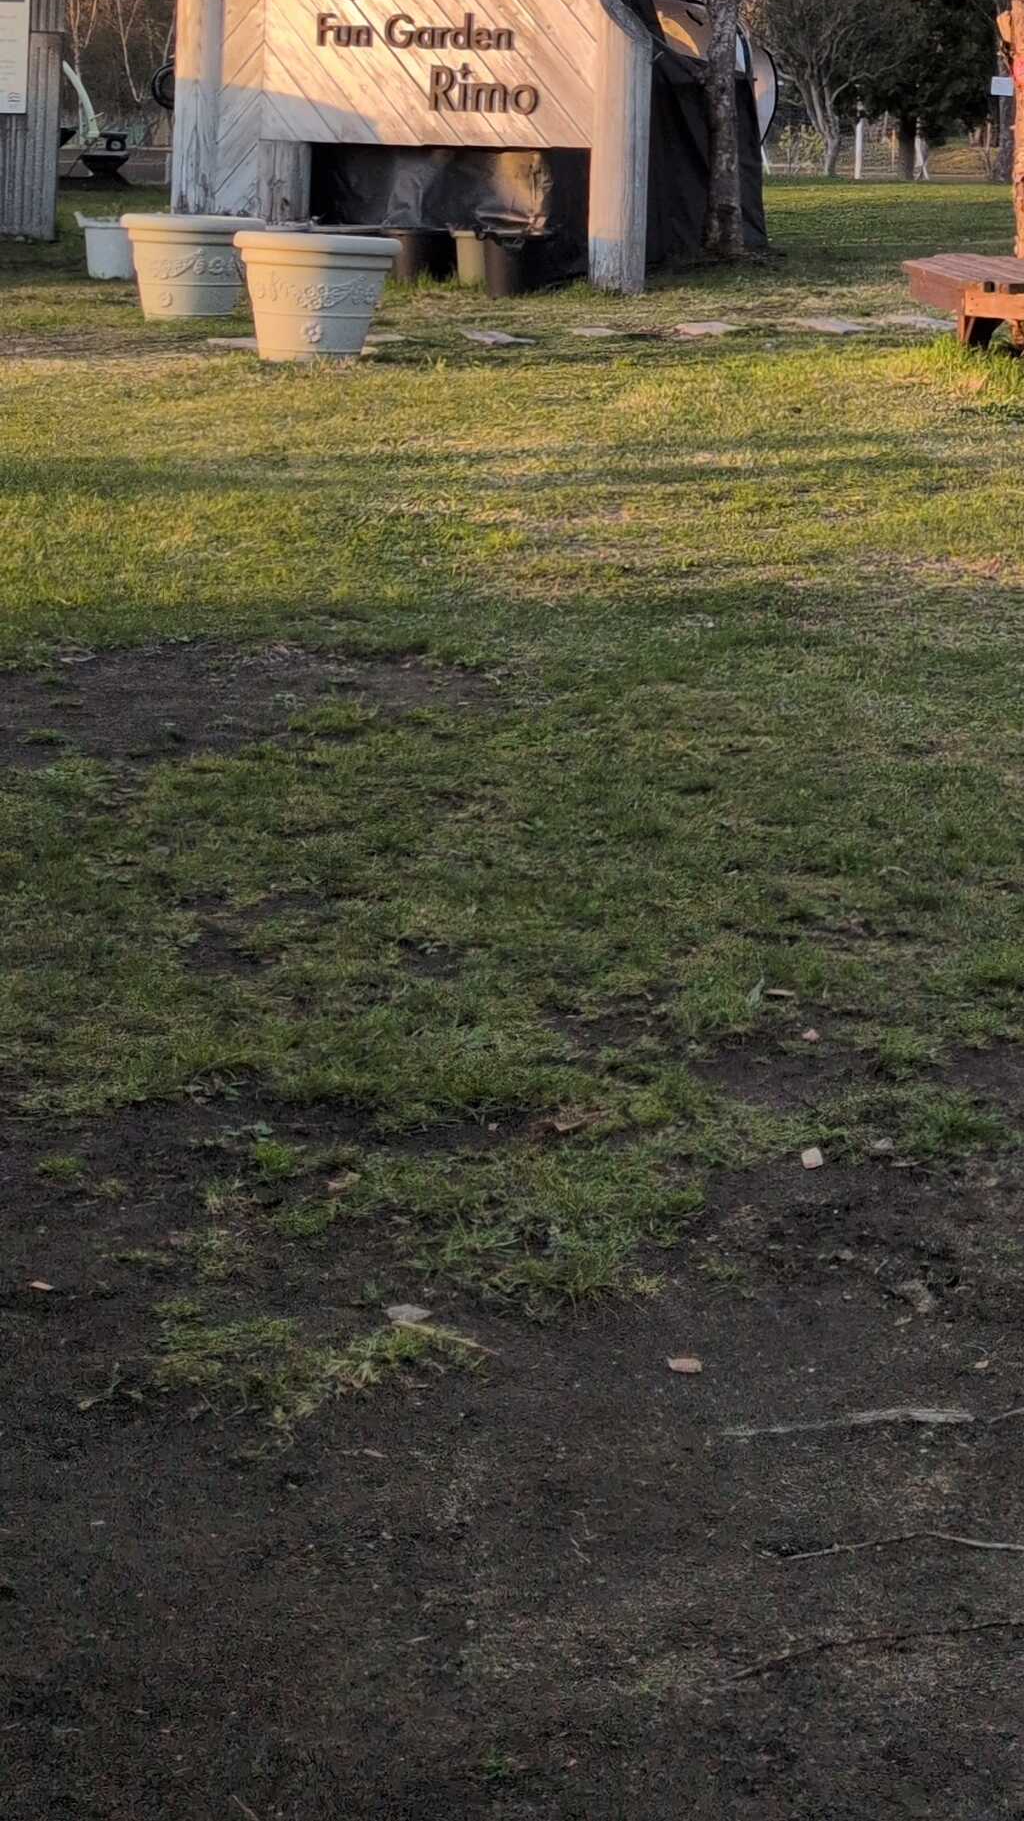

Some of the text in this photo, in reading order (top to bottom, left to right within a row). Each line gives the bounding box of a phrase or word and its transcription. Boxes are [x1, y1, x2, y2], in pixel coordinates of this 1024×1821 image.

[317, 12, 515, 51] Fun Garden
[429, 62, 540, 115] Rimo
